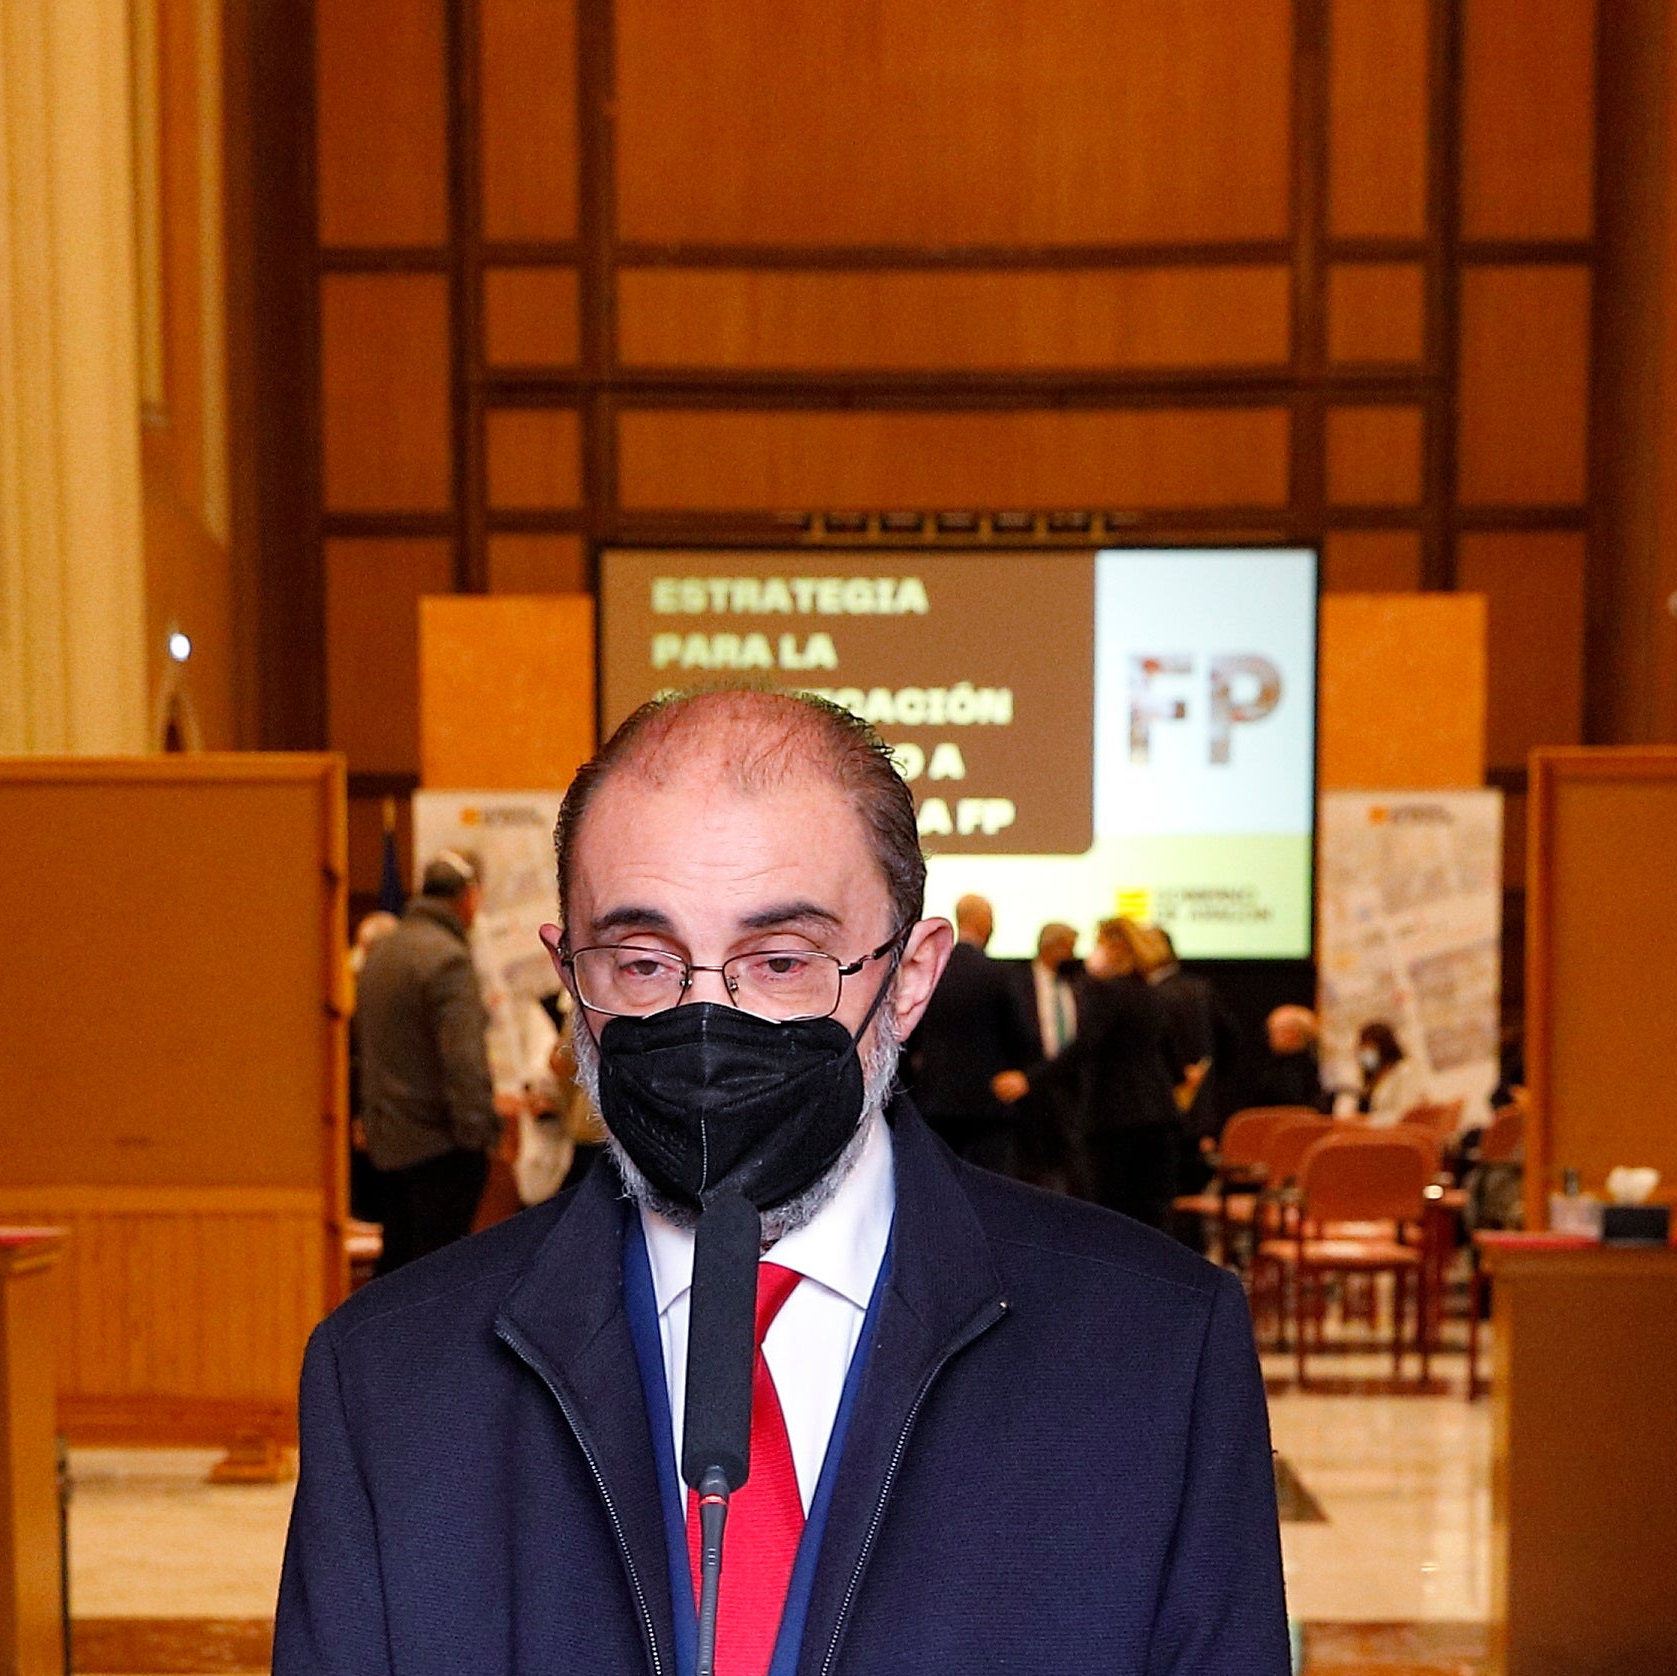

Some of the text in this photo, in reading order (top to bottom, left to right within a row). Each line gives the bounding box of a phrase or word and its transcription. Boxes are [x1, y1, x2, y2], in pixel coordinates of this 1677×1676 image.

[652, 576, 930, 615] ESTRATEGIA
[652, 632, 839, 670] PARA LA
[1129, 654, 1283, 766] FP
[928, 742, 966, 781] A
[956, 797, 1016, 836] FP
